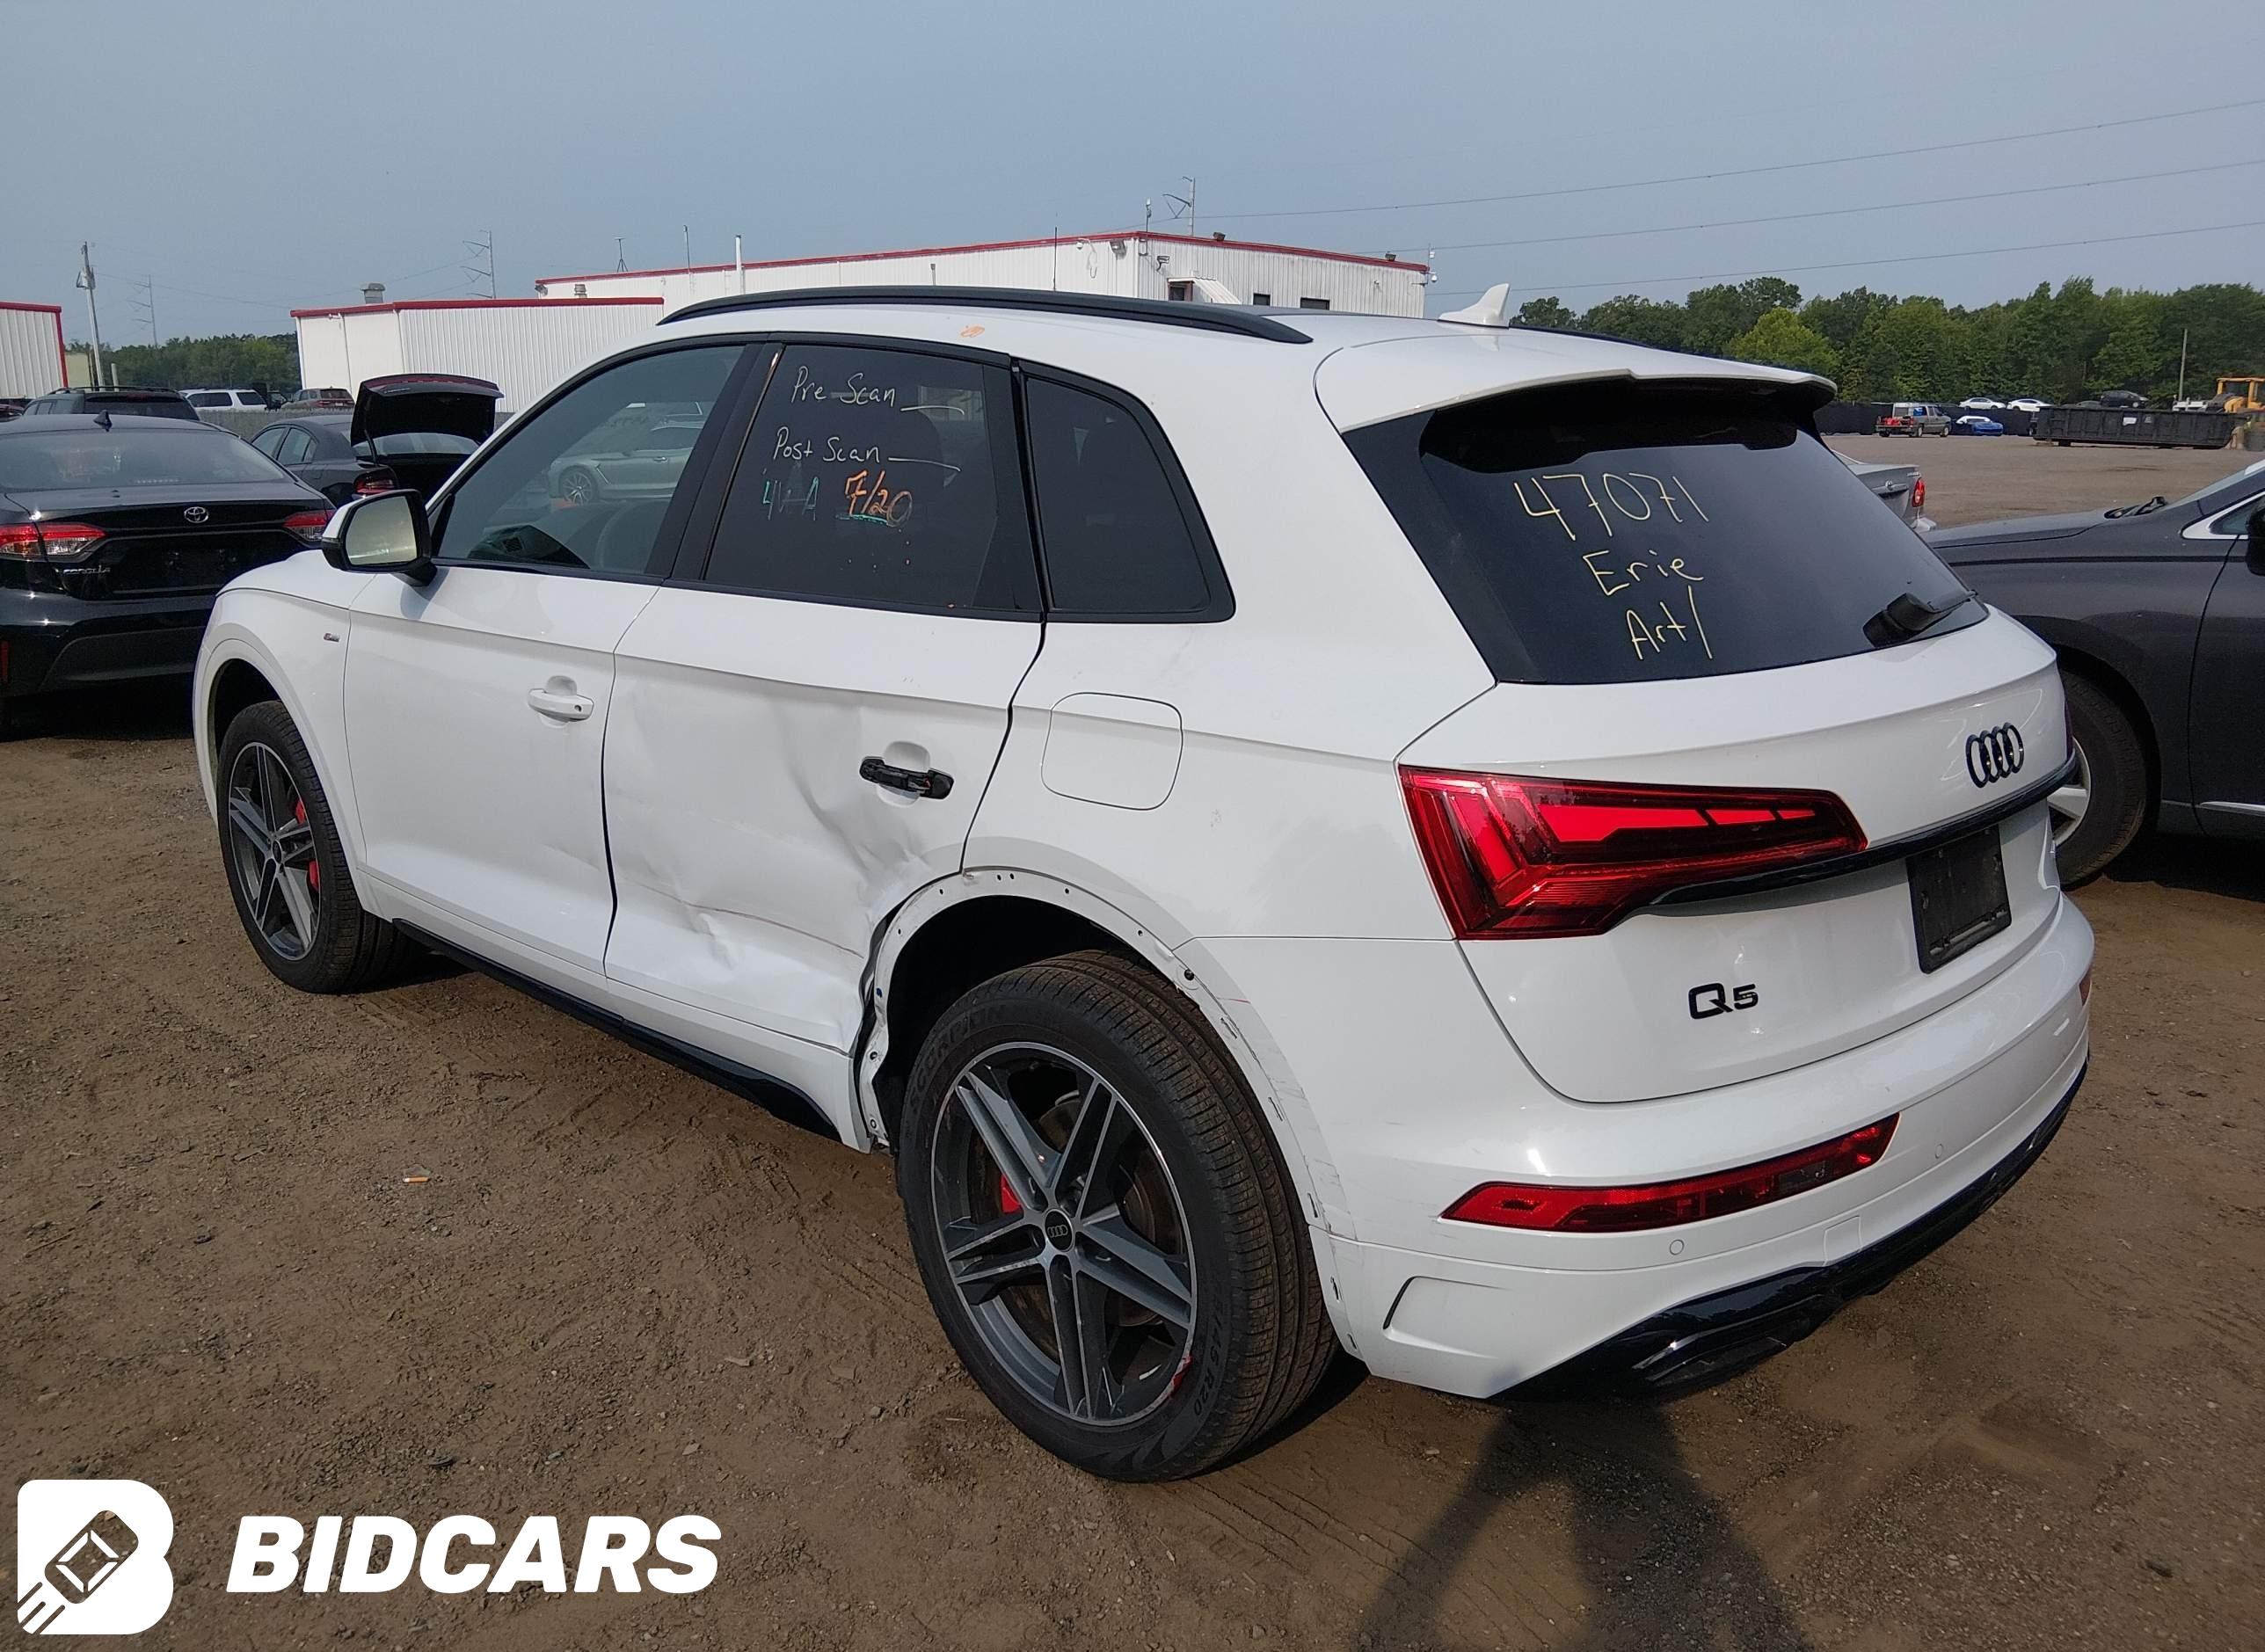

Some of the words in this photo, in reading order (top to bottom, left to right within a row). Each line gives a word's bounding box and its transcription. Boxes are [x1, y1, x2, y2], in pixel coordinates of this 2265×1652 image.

[840, 373, 895, 407] Scan
[774, 426, 812, 460] Post
[823, 437, 880, 462] Scan
[1514, 472, 1709, 541] 47071
[1583, 549, 1704, 595] Erie
[1688, 982, 1759, 1020] Q5
